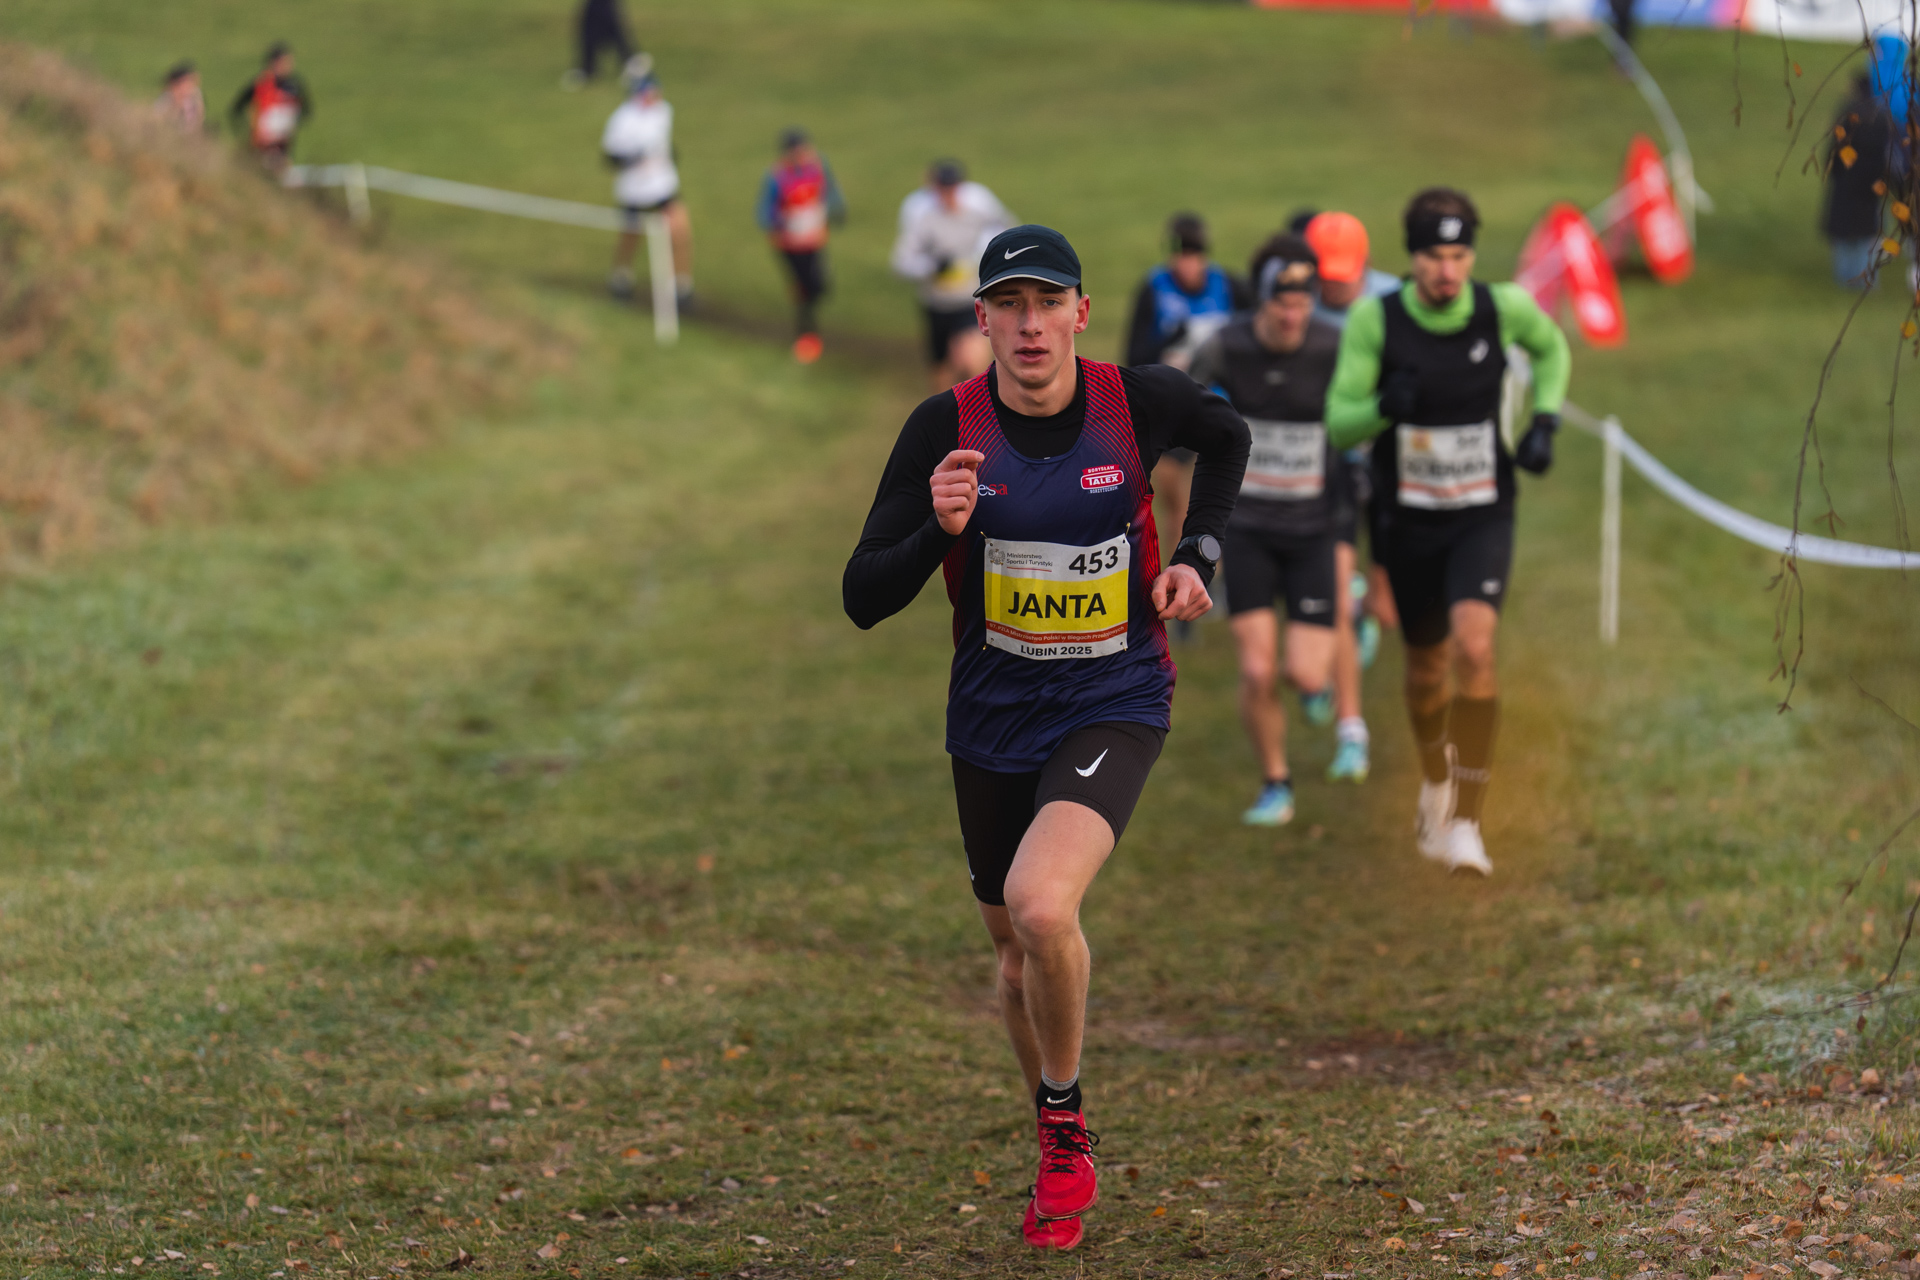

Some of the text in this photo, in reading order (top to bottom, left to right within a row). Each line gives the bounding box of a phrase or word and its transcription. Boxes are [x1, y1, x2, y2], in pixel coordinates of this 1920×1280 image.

[1085, 473, 1119, 486] TALEX
[1069, 546, 1118, 575] 453
[1007, 591, 1107, 619] JANTA
[1010, 630, 1043, 641] Mistrzostwa
[1020, 645, 1092, 657] LUBIN 2025
